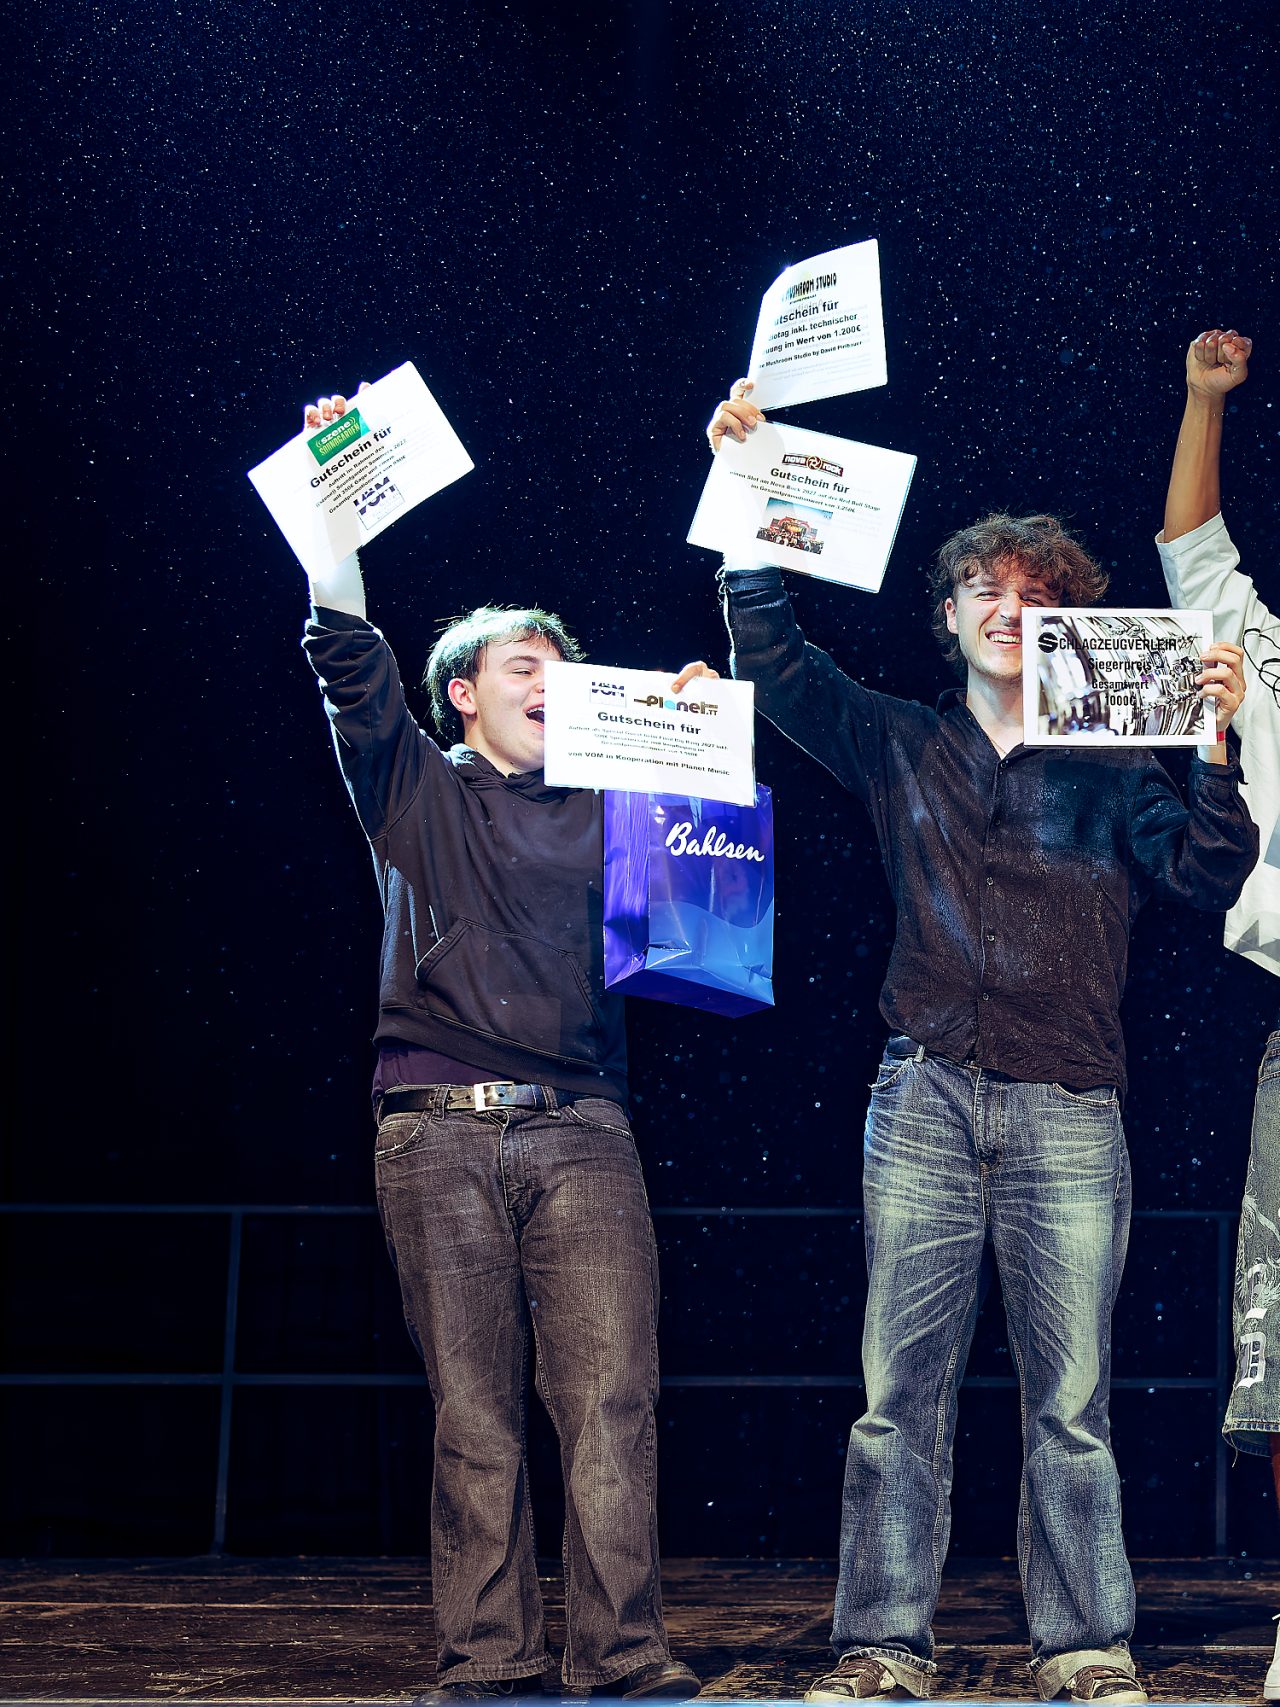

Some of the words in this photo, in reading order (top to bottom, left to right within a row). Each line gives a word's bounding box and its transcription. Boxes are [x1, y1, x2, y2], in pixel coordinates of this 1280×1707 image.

[816, 272, 837, 290] STUDIO
[774, 302, 818, 326] utschein
[822, 299, 839, 312] für
[810, 314, 857, 330] technischer
[796, 336, 815, 345] Wert
[817, 333, 831, 341] von
[834, 325, 861, 336] 1.200€
[310, 441, 372, 489] Gutschein
[374, 425, 392, 442] für
[770, 467, 829, 490] Gutschein
[832, 481, 850, 495] für
[1089, 657, 1151, 672] Siegerpreis
[1092, 679, 1149, 690] Gesamtwert
[597, 711, 675, 731] Gutschein
[680, 723, 701, 735] für
[665, 822, 765, 862] Bahlsen
